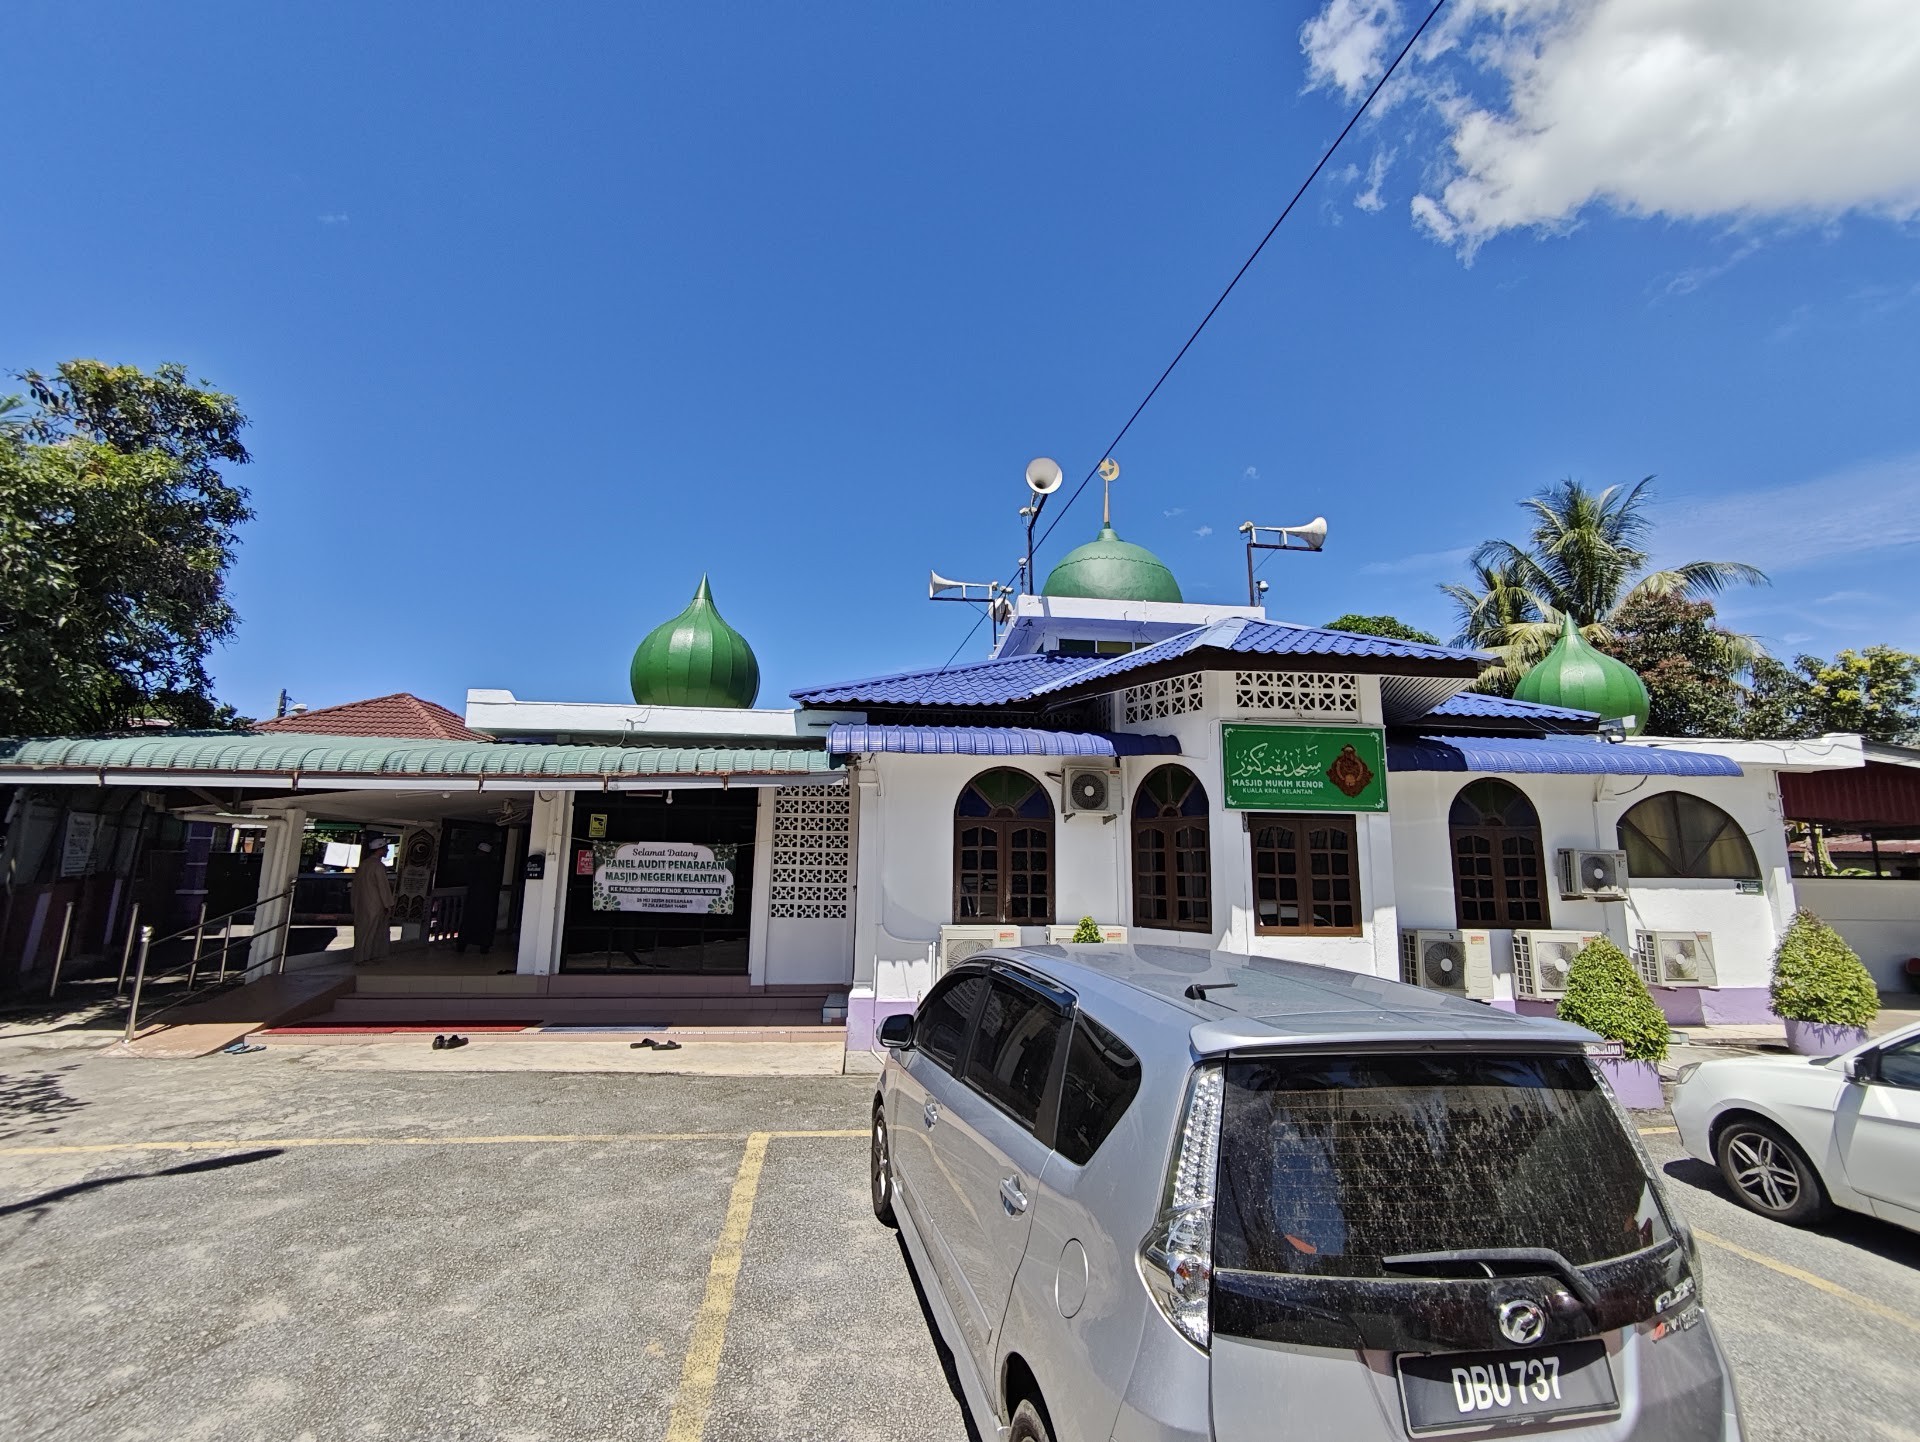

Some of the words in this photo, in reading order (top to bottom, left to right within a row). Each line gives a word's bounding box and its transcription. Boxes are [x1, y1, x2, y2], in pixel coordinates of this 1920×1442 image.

[1232, 779, 1263, 787] MASJID
[1265, 780, 1293, 788] MUKIM
[1295, 781, 1324, 789] KENOR
[632, 848, 666, 857] Selamat
[667, 849, 699, 860] Datang
[605, 859, 636, 870] PANEL
[637, 860, 667, 870] AUDIT
[668, 860, 726, 871] PENARAFAN
[605, 872, 638, 883] MASJID
[640, 872, 675, 882] NEGERI
[676, 873, 726, 884] KELANTAN
[1449, 932, 1454, 940] 5
[1451, 1363, 1512, 1413] DBU
[1510, 1356, 1562, 1404] 737
